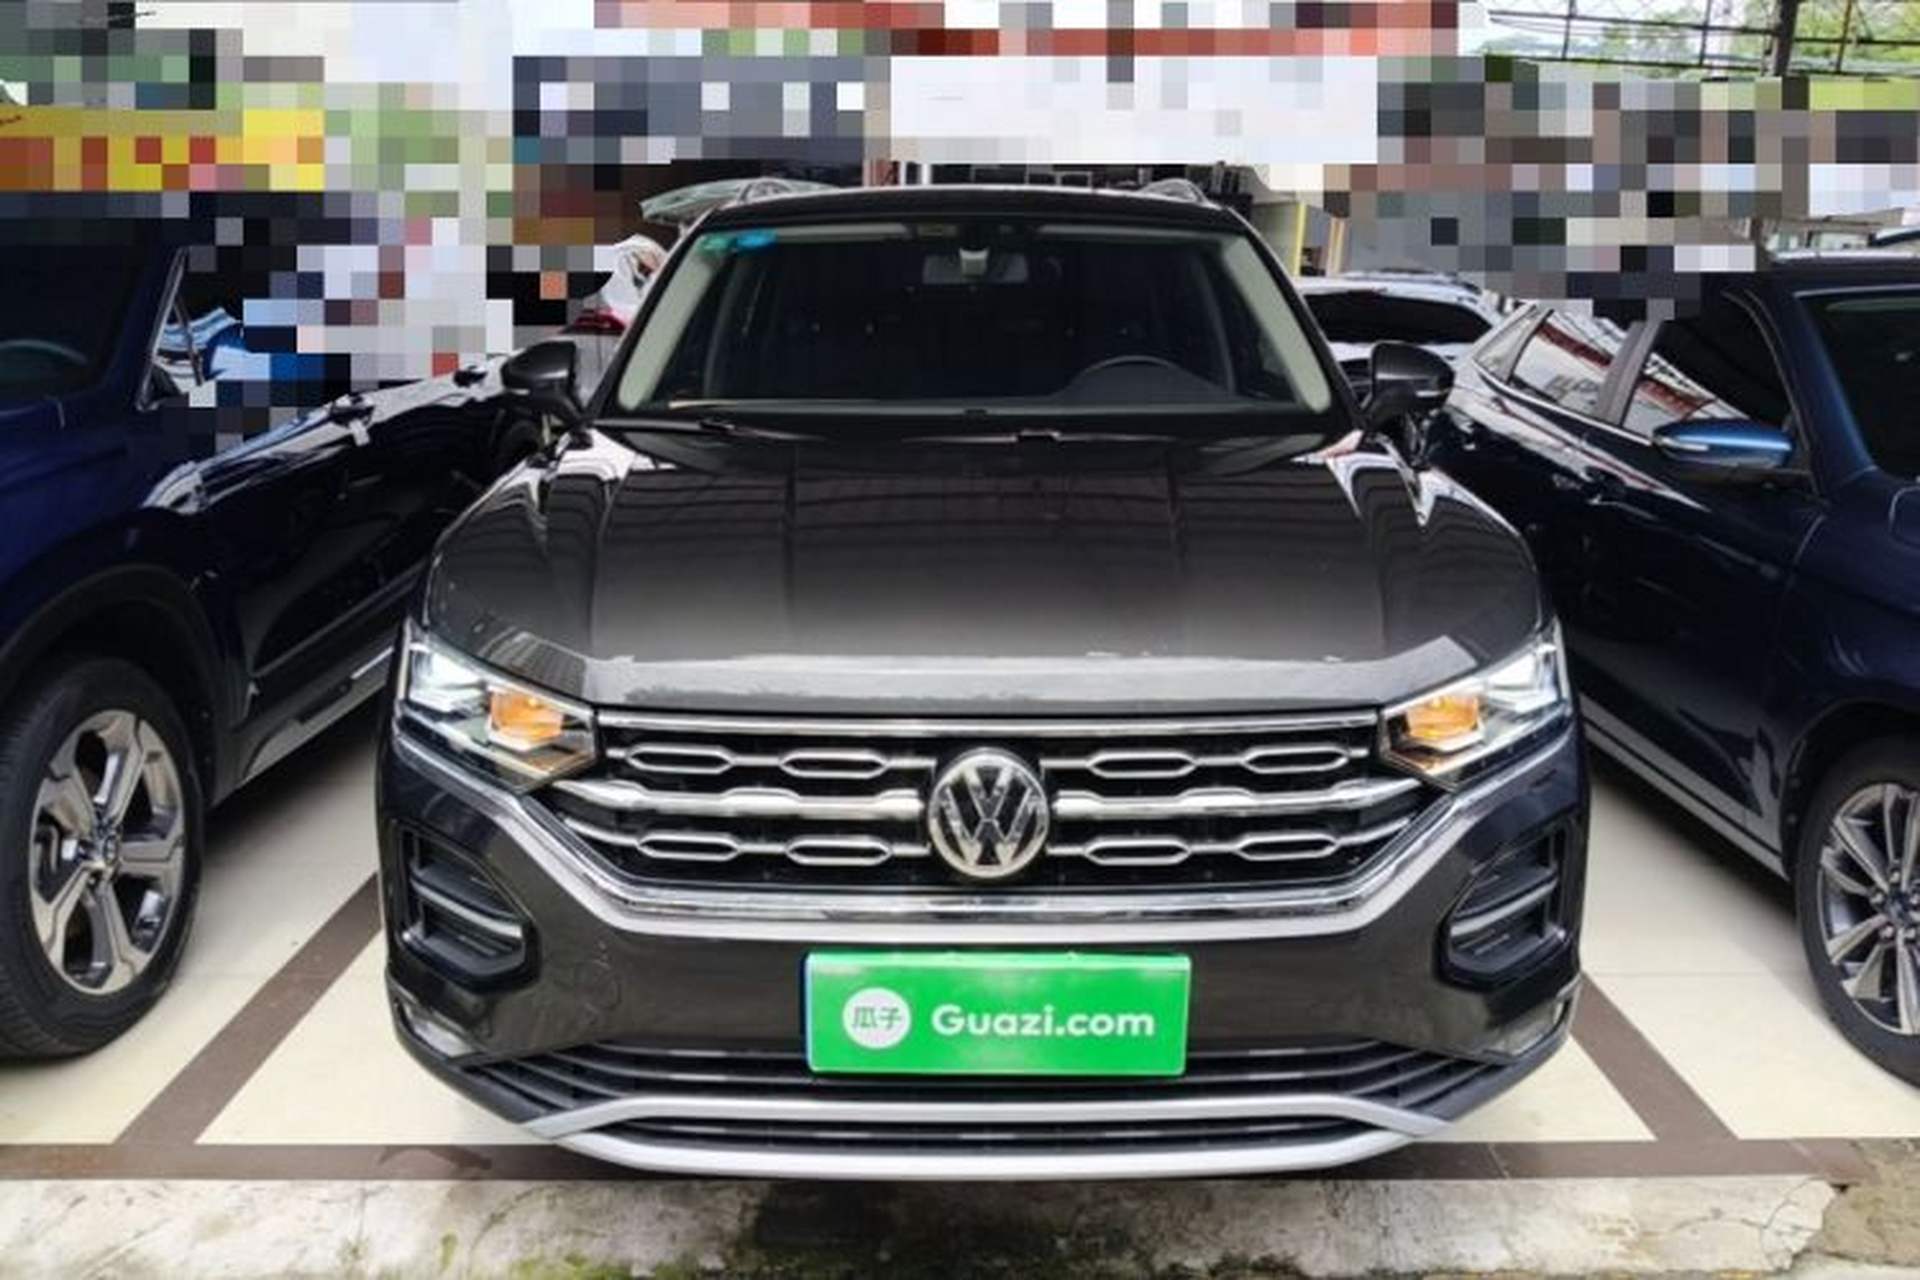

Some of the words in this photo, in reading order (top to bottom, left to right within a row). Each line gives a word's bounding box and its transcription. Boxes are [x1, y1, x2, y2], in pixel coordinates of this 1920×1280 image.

[930, 749, 1048, 877] VW
[852, 1006, 902, 1031] 瓜子
[931, 1003, 1155, 1037] Guazi.com
